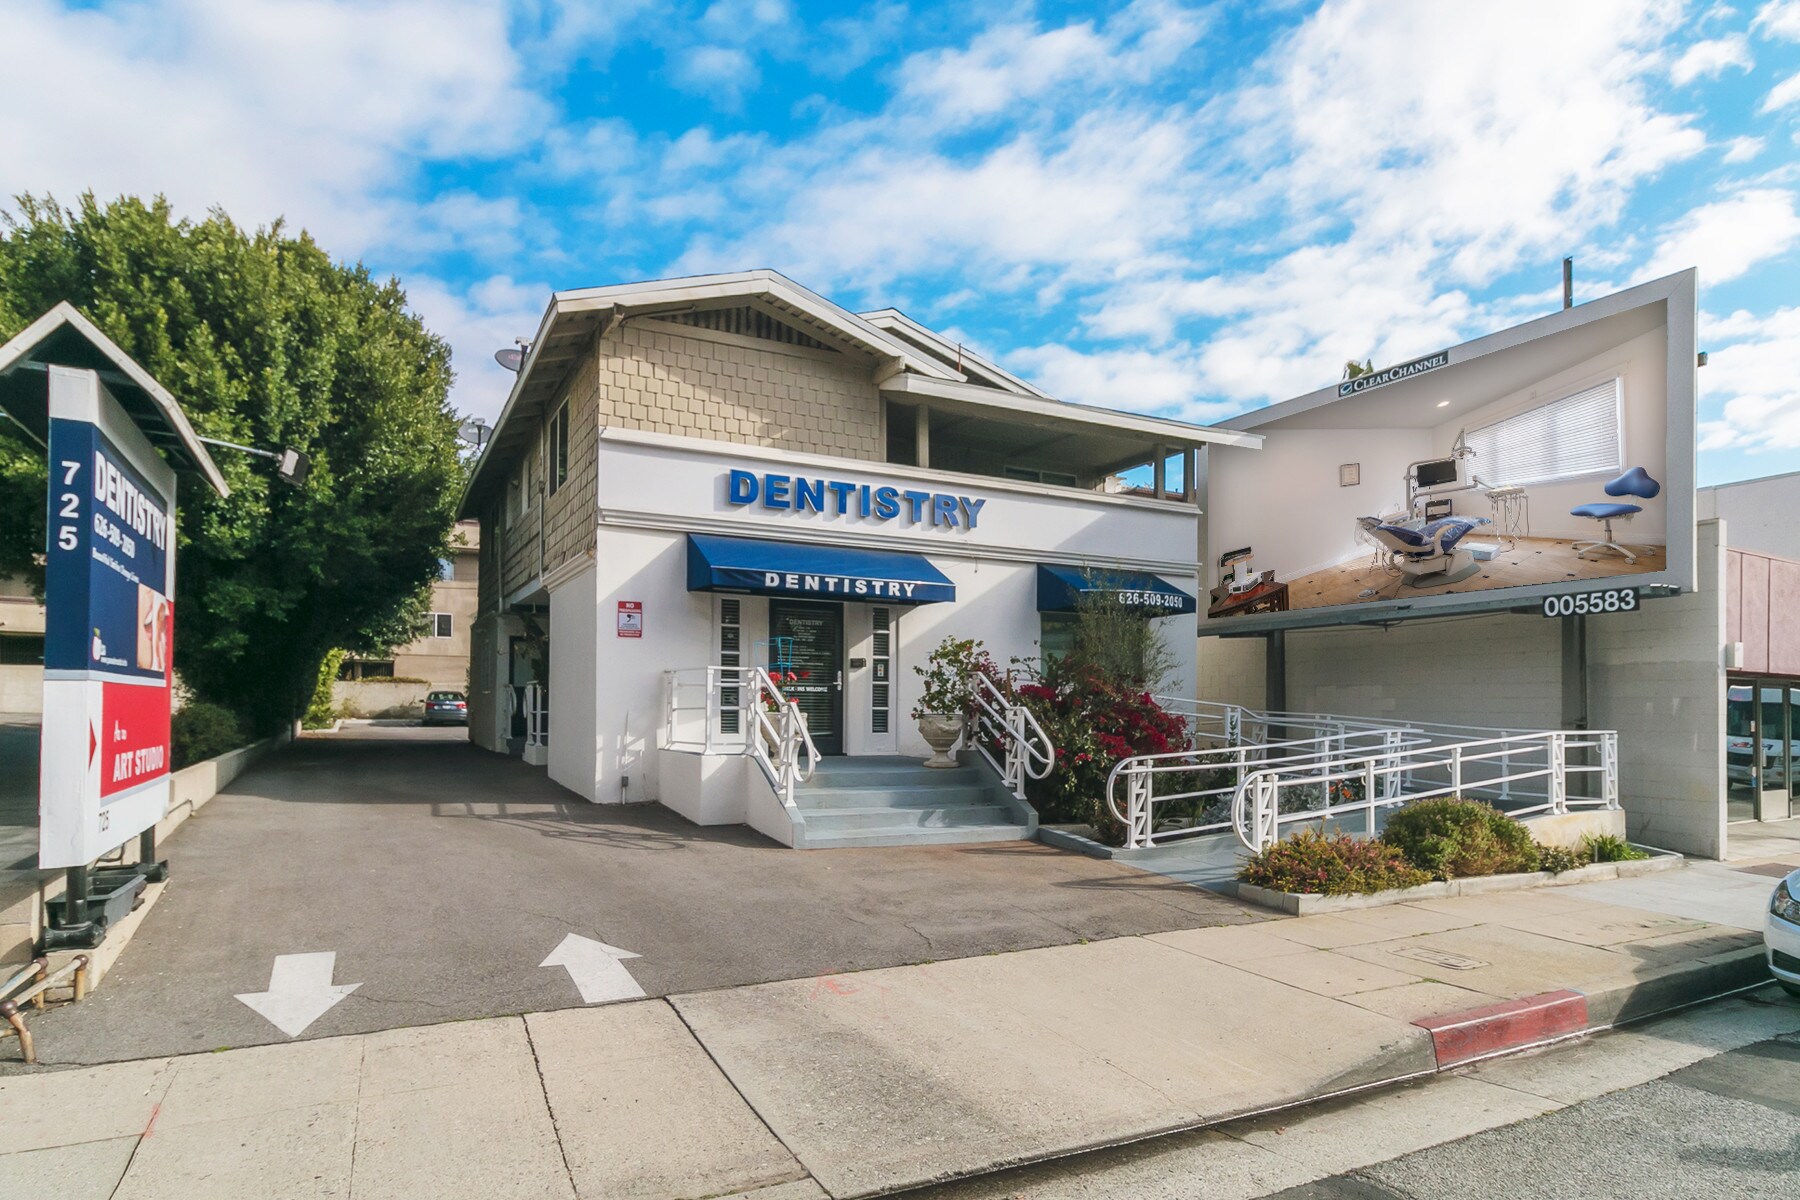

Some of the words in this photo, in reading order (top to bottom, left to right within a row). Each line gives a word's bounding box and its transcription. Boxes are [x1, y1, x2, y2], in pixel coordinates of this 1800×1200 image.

[59, 460, 81, 551] 725
[95, 450, 167, 551] DENTISTRY
[729, 469, 986, 529] DENTISTRY
[764, 572, 915, 598] DENTISTRY
[1118, 592, 1183, 609] 626-509-2050
[1544, 589, 1636, 617] 005583
[113, 750, 134, 783] ART
[134, 744, 164, 776] STUDIO
